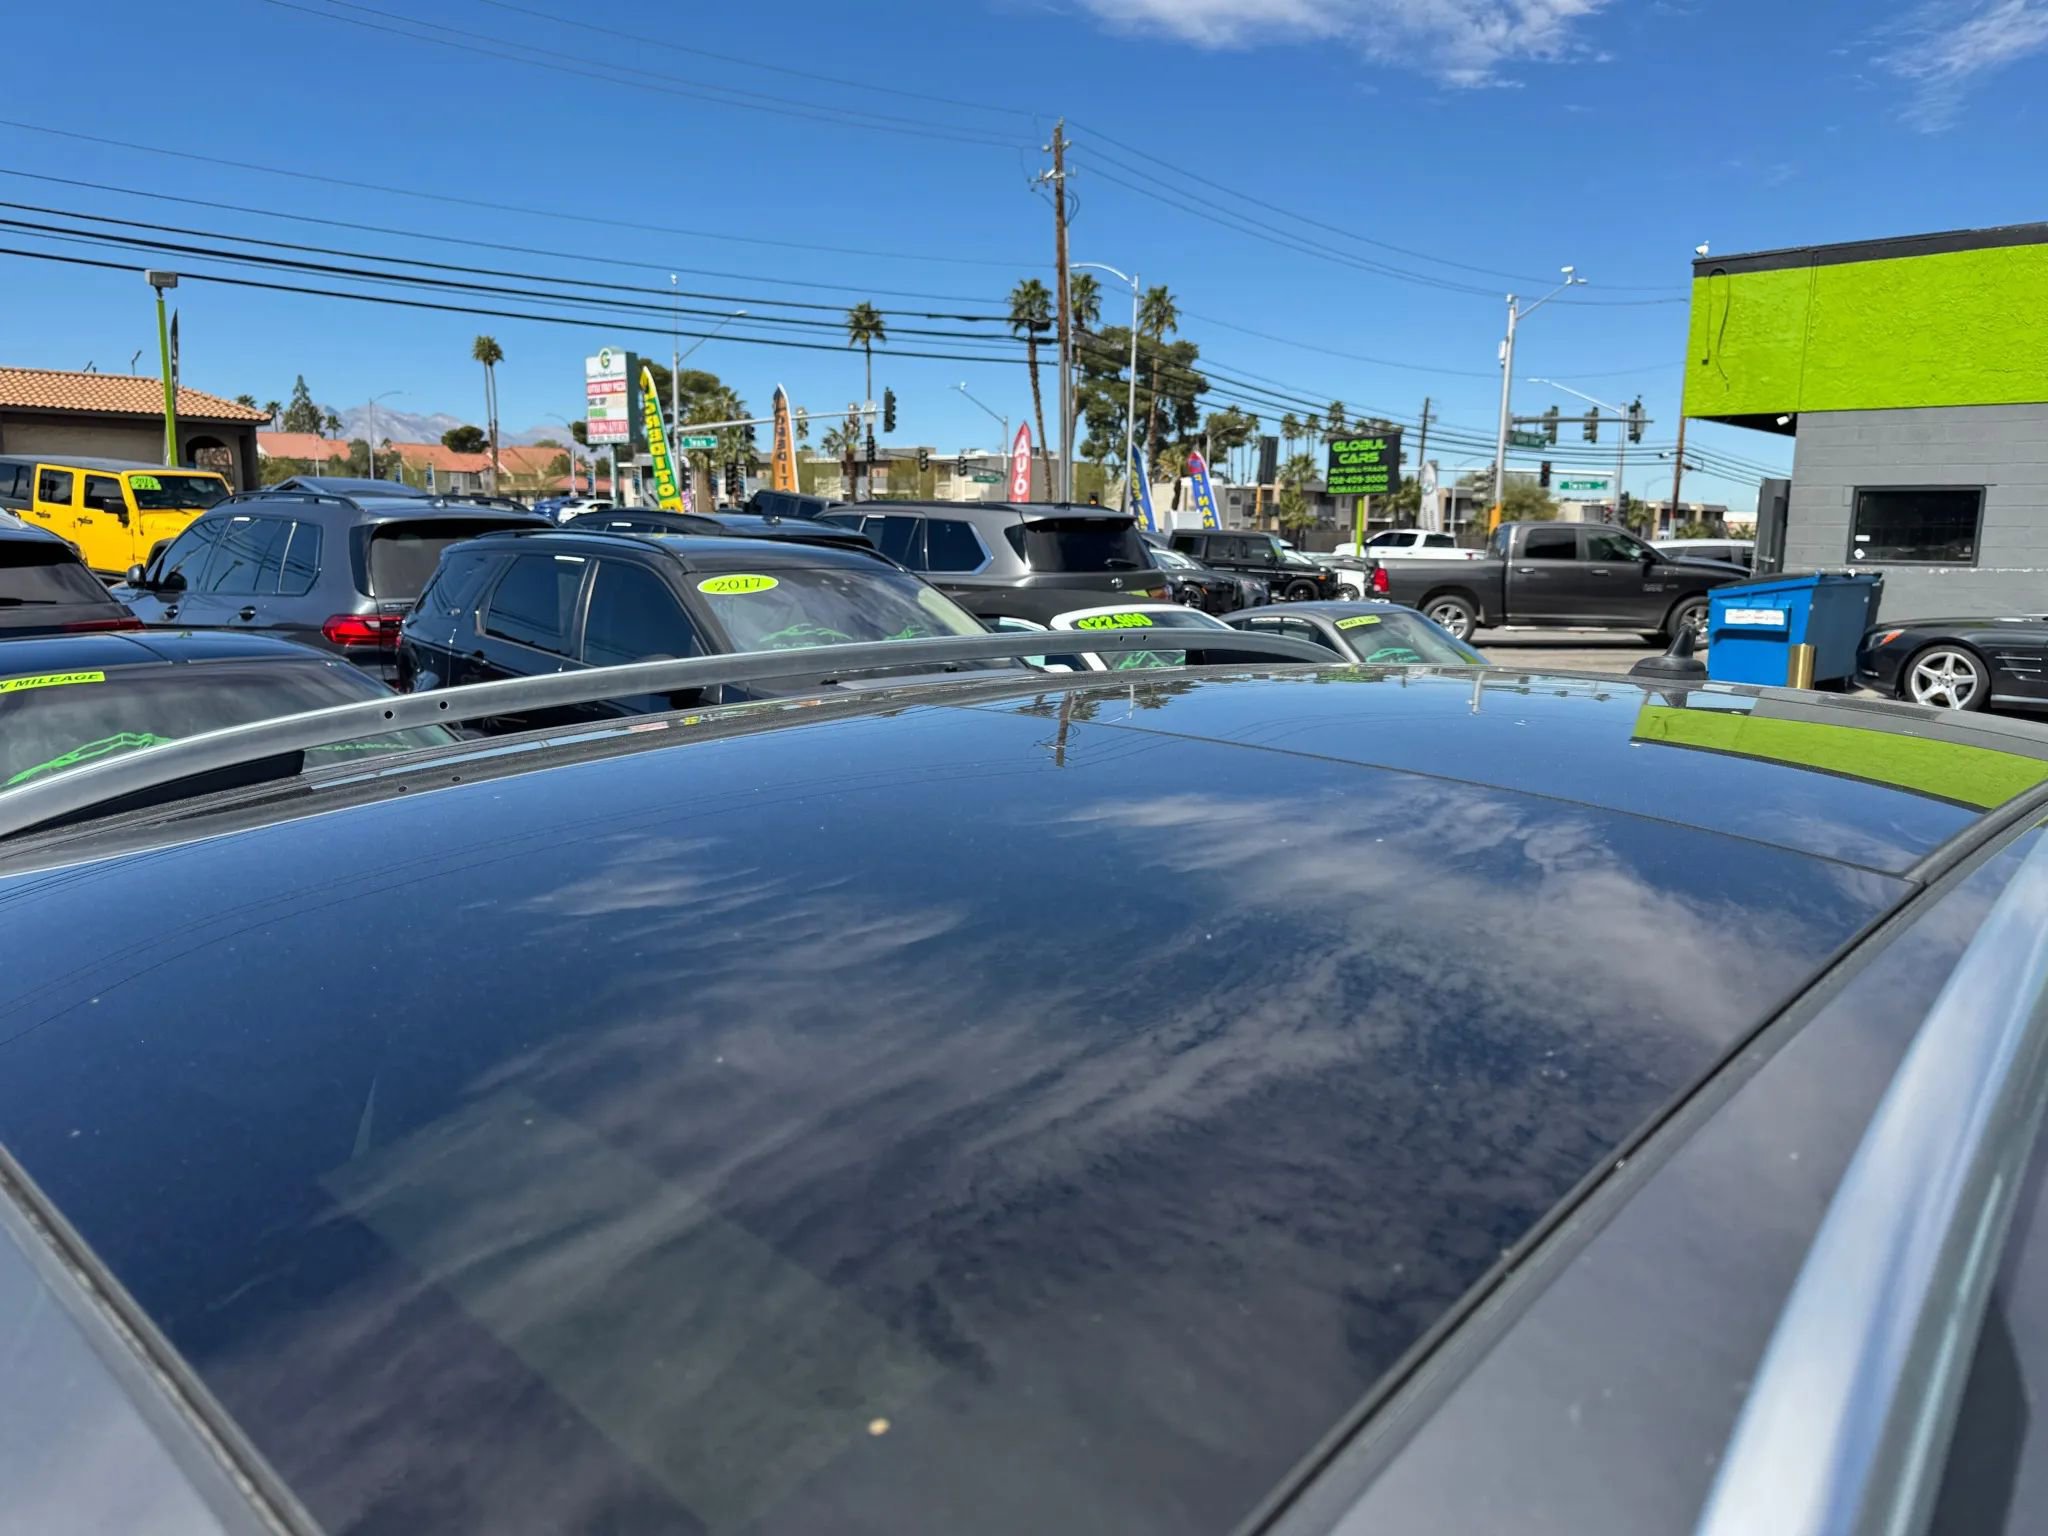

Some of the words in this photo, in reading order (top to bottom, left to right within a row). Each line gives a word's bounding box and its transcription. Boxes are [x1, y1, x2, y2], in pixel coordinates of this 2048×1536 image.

[1338, 452, 1379, 464] CARS
[714, 578, 761, 592] 2017
[15, 674, 100, 688] MILEAGE
